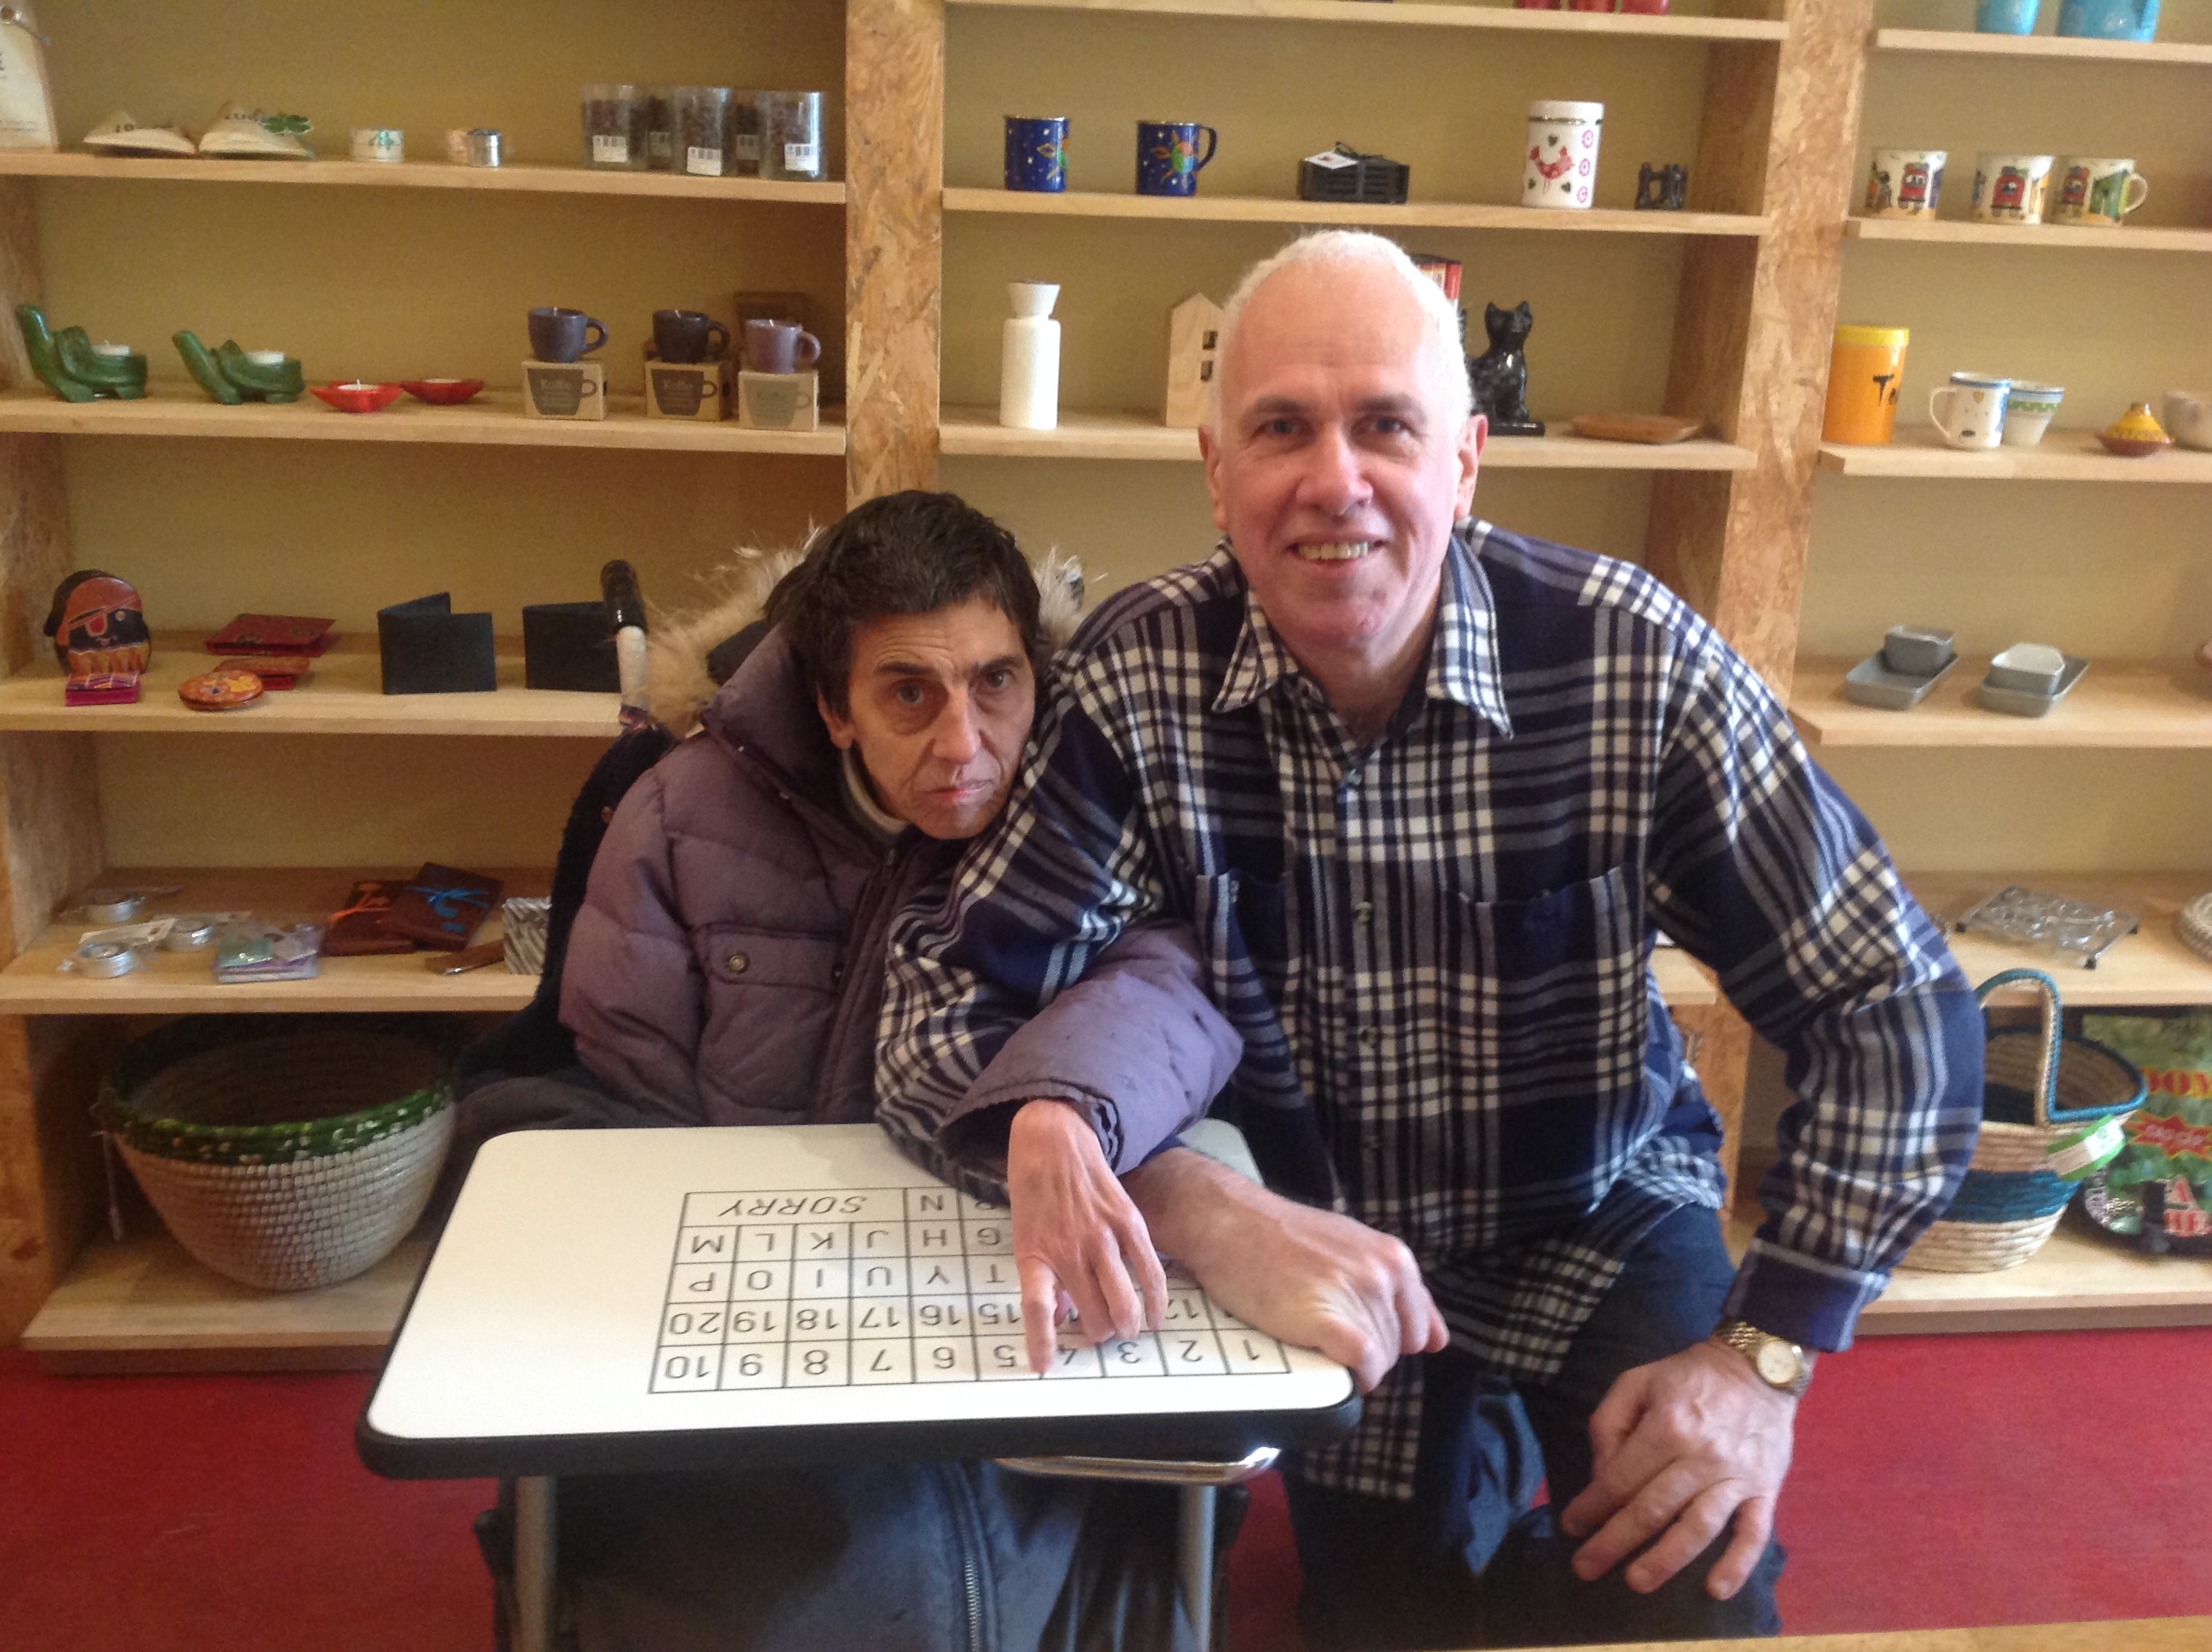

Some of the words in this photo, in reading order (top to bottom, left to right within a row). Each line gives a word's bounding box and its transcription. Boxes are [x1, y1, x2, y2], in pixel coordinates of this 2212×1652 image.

[718, 1196, 867, 1217] SORRY
[921, 1195, 943, 1211] N
[691, 1235, 724, 1254] M
[756, 1233, 775, 1252] L
[811, 1232, 834, 1250] K
[867, 1230, 888, 1248] J
[923, 1229, 946, 1247] H
[977, 1228, 1000, 1246] G
[689, 1272, 715, 1292] P
[747, 1271, 772, 1290] O
[867, 1266, 891, 1286] U
[927, 1266, 949, 1284] Y
[987, 1265, 1004, 1283] T
[668, 1312, 722, 1335] 20
[733, 1311, 777, 1332] 19
[796, 1309, 839, 1330] 18
[859, 1306, 899, 1329] 17
[919, 1305, 962, 1326] 16
[978, 1304, 1022, 1325] 15
[870, 1349, 892, 1371] 7
[933, 1347, 955, 1370] 6
[993, 1345, 1017, 1368] 5
[1117, 1340, 1141, 1364] 3
[1179, 1341, 1202, 1362] 2
[1243, 1340, 1260, 1361] 1
[665, 1356, 709, 1379] 10
[739, 1353, 762, 1376] 9
[804, 1350, 830, 1376] 8
